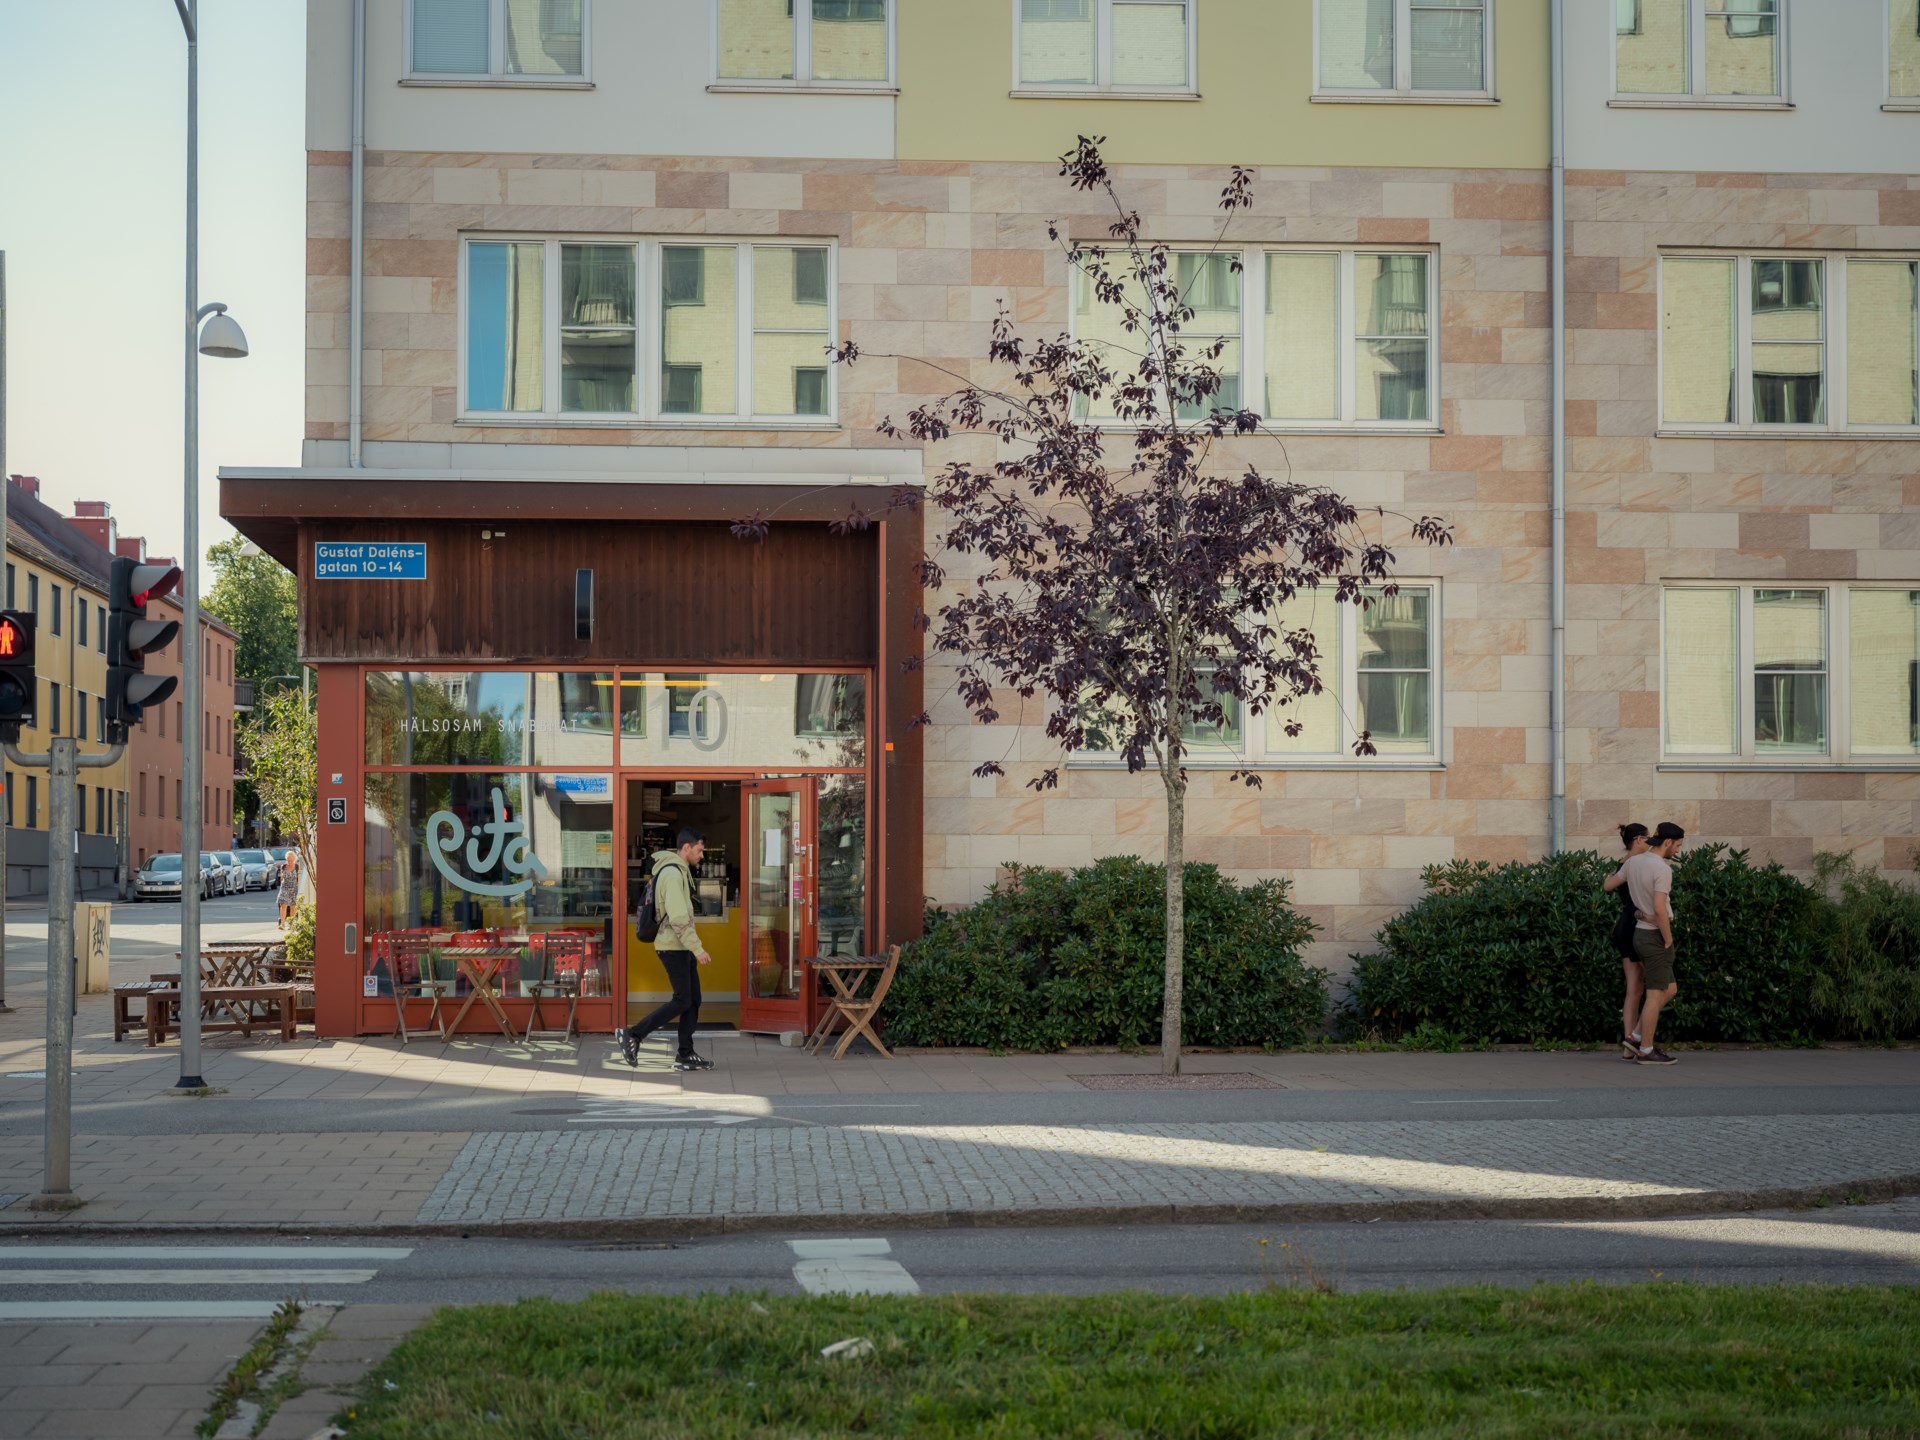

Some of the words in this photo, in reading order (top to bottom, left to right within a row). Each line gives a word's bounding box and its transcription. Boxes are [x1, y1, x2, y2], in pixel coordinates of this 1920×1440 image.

[318, 546, 364, 558] Gustaf
[368, 546, 423, 558] Daléns-
[318, 561, 358, 575] gatan
[400, 716, 482, 733] HÄLSOSAM
[647, 688, 729, 752] 10
